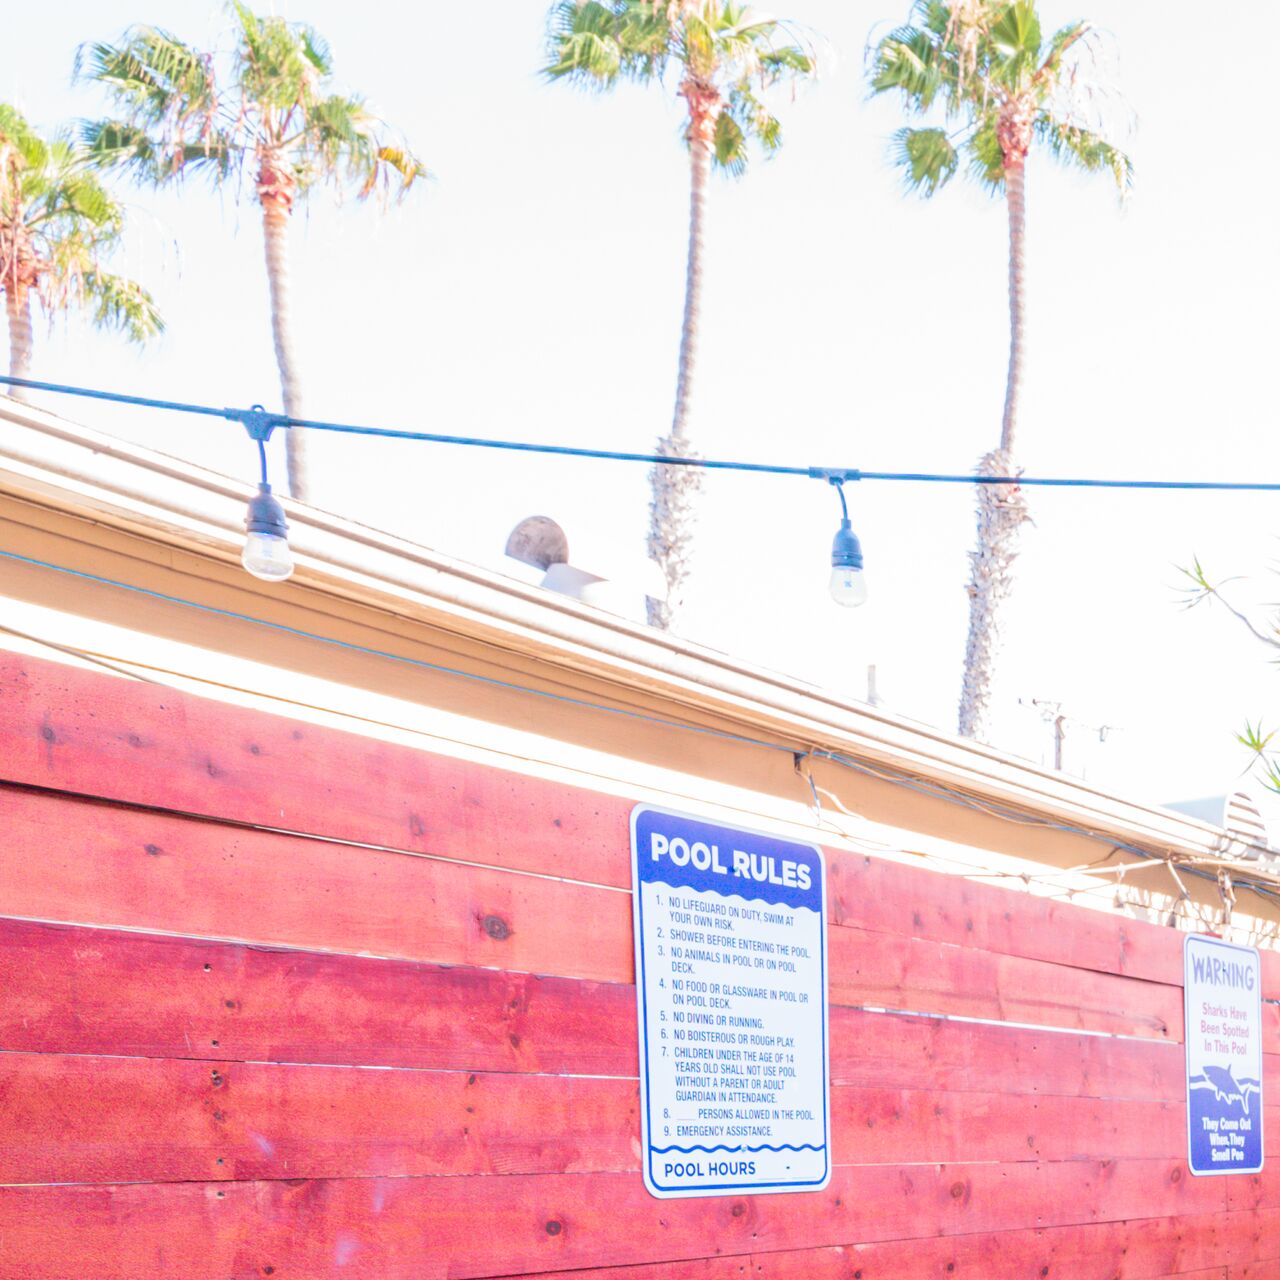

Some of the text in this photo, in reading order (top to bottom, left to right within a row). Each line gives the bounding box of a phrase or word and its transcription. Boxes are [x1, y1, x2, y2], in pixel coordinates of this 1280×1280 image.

[651, 832, 812, 890] POOL RULES
[656, 895, 794, 926] 1. NO LIFEGUARD ON DUTY, SWIM AT
[670, 912, 734, 931] YOUR OWN RISK.
[657, 928, 811, 958] 2. SHOWER BEFORE ENTERING THE POOL.
[658, 945, 796, 972] 3. NO ANIMALS IN POOL OR ON POOL
[672, 962, 695, 974] DECK.
[1192, 952, 1255, 991] WARNING
[659, 979, 808, 1003] 4. NO FOOD OR GLASSWARE IN POOL OR
[673, 994, 732, 1009] ON POOL DECK.
[660, 1011, 764, 1028] 5. NO DIVING OR RUNNING.
[1202, 1002, 1247, 1021] Sharks Have
[1200, 1020, 1250, 1038] Been Spotted
[661, 1029, 795, 1047] 6. NO BOISTEROUS OR ROUGH PLAY.
[662, 1047, 794, 1063] 7. CHILDREN UNDER THE AGE OF 14
[1204, 1039, 1247, 1055] In This Pool
[675, 1062, 796, 1077] YEARS OLD SHALL NOT USE POOL
[676, 1077, 785, 1090] WITHOUT A PARENT OR ADULT
[676, 1091, 777, 1103] GUARDIAN IN ATTENDANCE.
[664, 1108, 815, 1120] 8. PERSONS ALLOWED IN THE POOL.
[664, 1126, 773, 1136] 9. EMERGENCY ASSISTANCE.
[1202, 1117, 1251, 1132] They Come Out
[1229, 1132, 1245, 1147] They
[1211, 1148, 1244, 1162] Smell Pee
[664, 1161, 756, 1178] POOL HOURS
